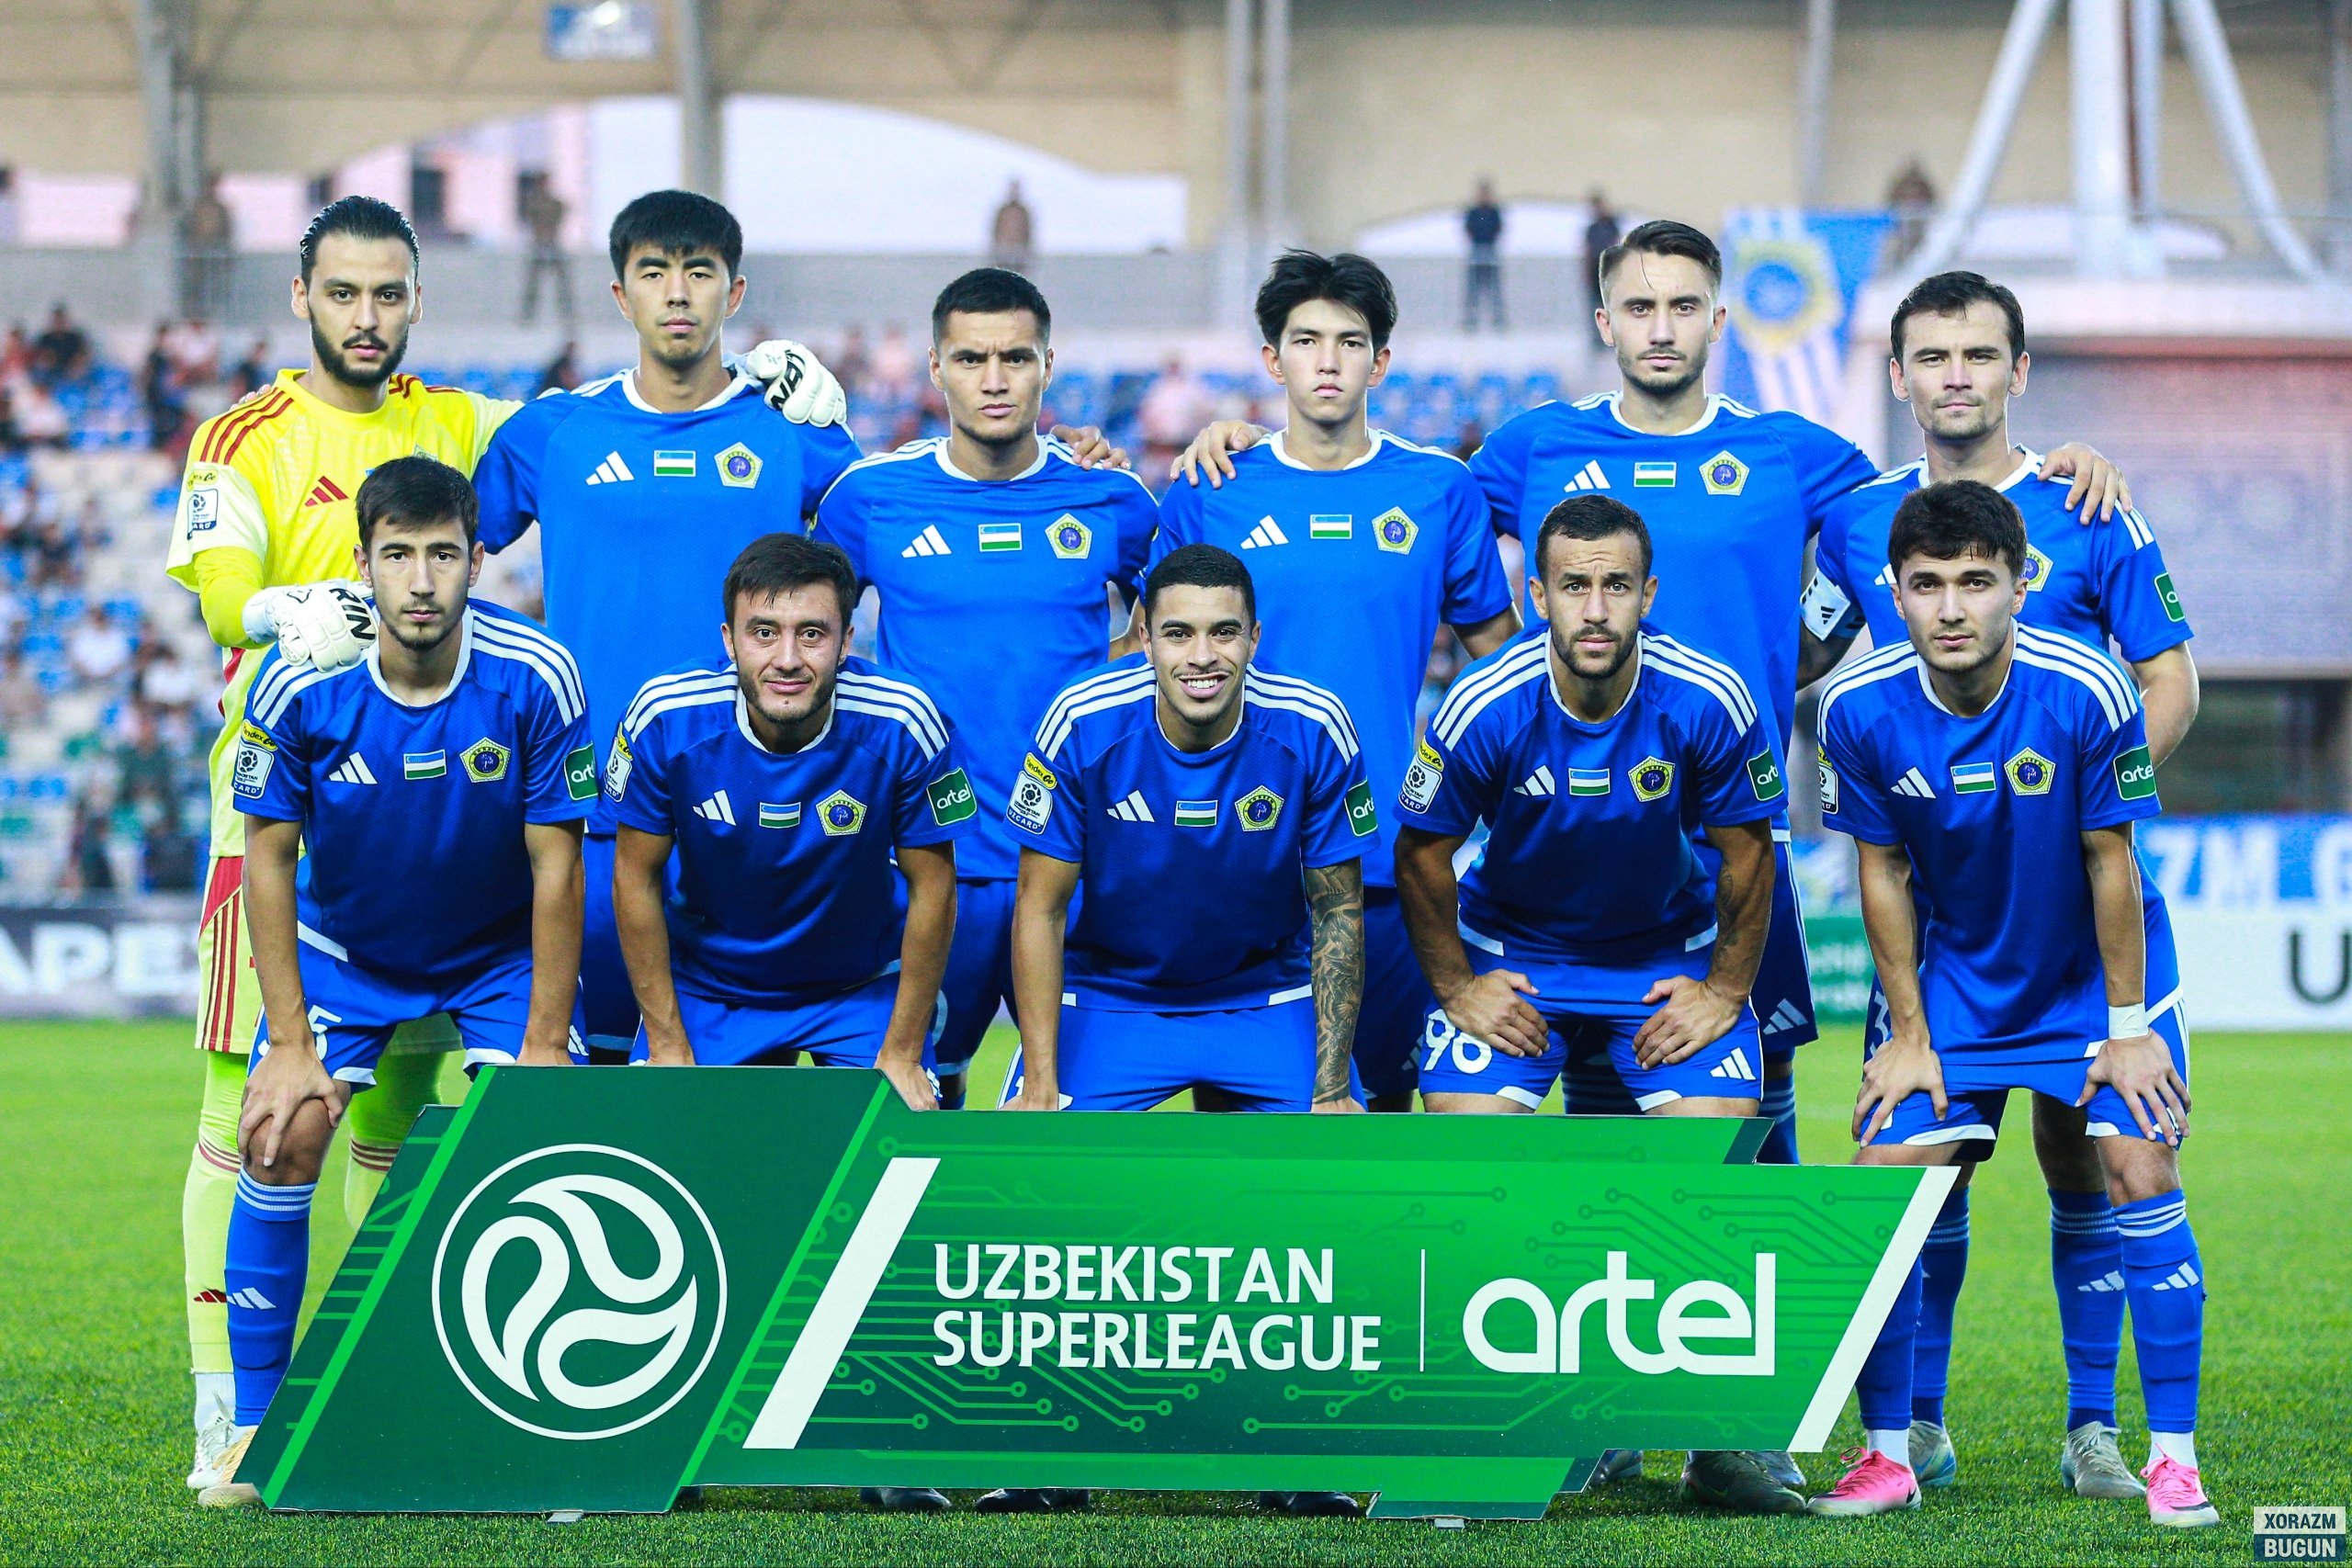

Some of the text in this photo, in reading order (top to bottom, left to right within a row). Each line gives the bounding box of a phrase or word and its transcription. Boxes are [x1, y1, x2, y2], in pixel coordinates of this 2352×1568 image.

[937, 783, 971, 809] artel
[933, 1243, 1334, 1303] UZBEKISTAN
[933, 1310, 1382, 1371] SUPERLEAGUE
[1462, 1250, 1777, 1376] artel
